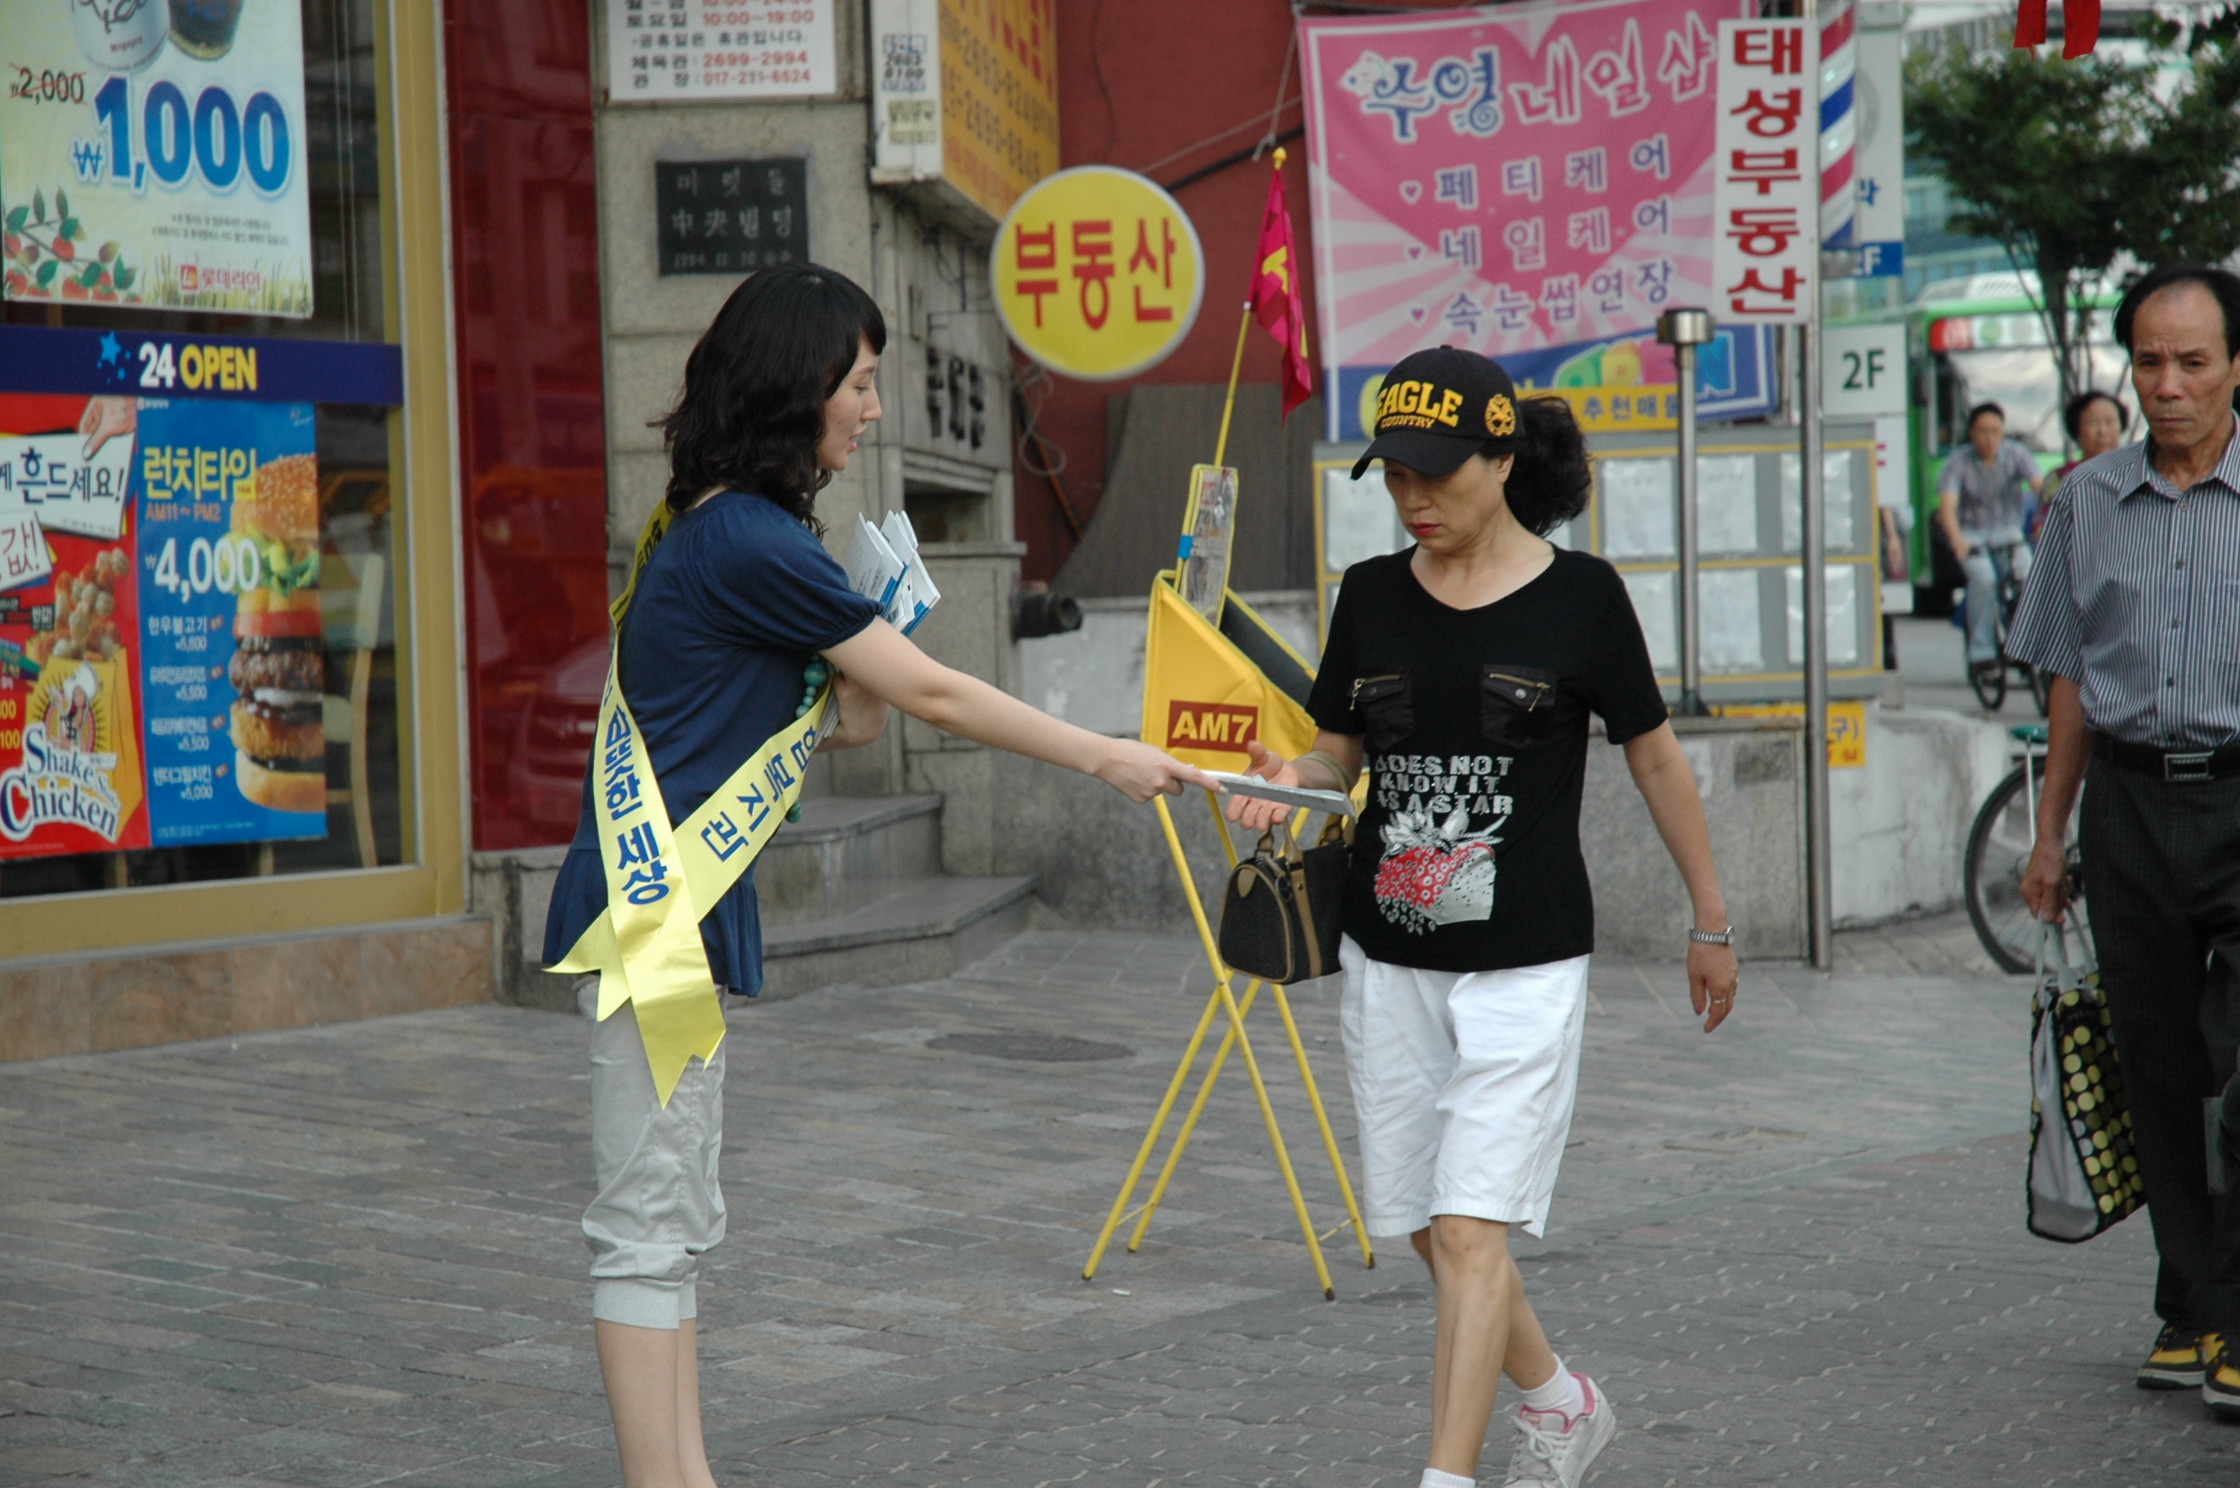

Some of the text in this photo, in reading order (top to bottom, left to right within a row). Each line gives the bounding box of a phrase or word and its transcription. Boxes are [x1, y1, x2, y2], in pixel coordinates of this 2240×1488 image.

[1366, 10, 1716, 138] 수영 네일샵
[1440, 138, 1666, 206] 페티케어
[1727, 27, 1806, 316] 태성부동산
[1445, 200, 1667, 268] 네일케어
[202, 267, 262, 292] 롯데리아
[1016, 217, 1176, 331] 부동산
[1445, 260, 1672, 334] 속눈썹연장
[139, 342, 257, 392] 24 OPEN
[1843, 350, 1885, 389] 2F
[1376, 380, 1464, 428] EAGLE
[1381, 415, 1435, 430] COUNTRY
[16, 446, 124, 504] 흔드세요!
[144, 445, 257, 501] 런치타임
[1171, 710, 1254, 745] AM7
[26, 728, 94, 784] Shake
[1380, 773, 1500, 795] KNOW IT
[1450, 755, 1514, 776] NOT
[1, 775, 116, 836] Chicken
[605, 704, 671, 905] 따뜻한 세상
[1405, 793, 1424, 813] A
[1431, 794, 1515, 816] STAR
